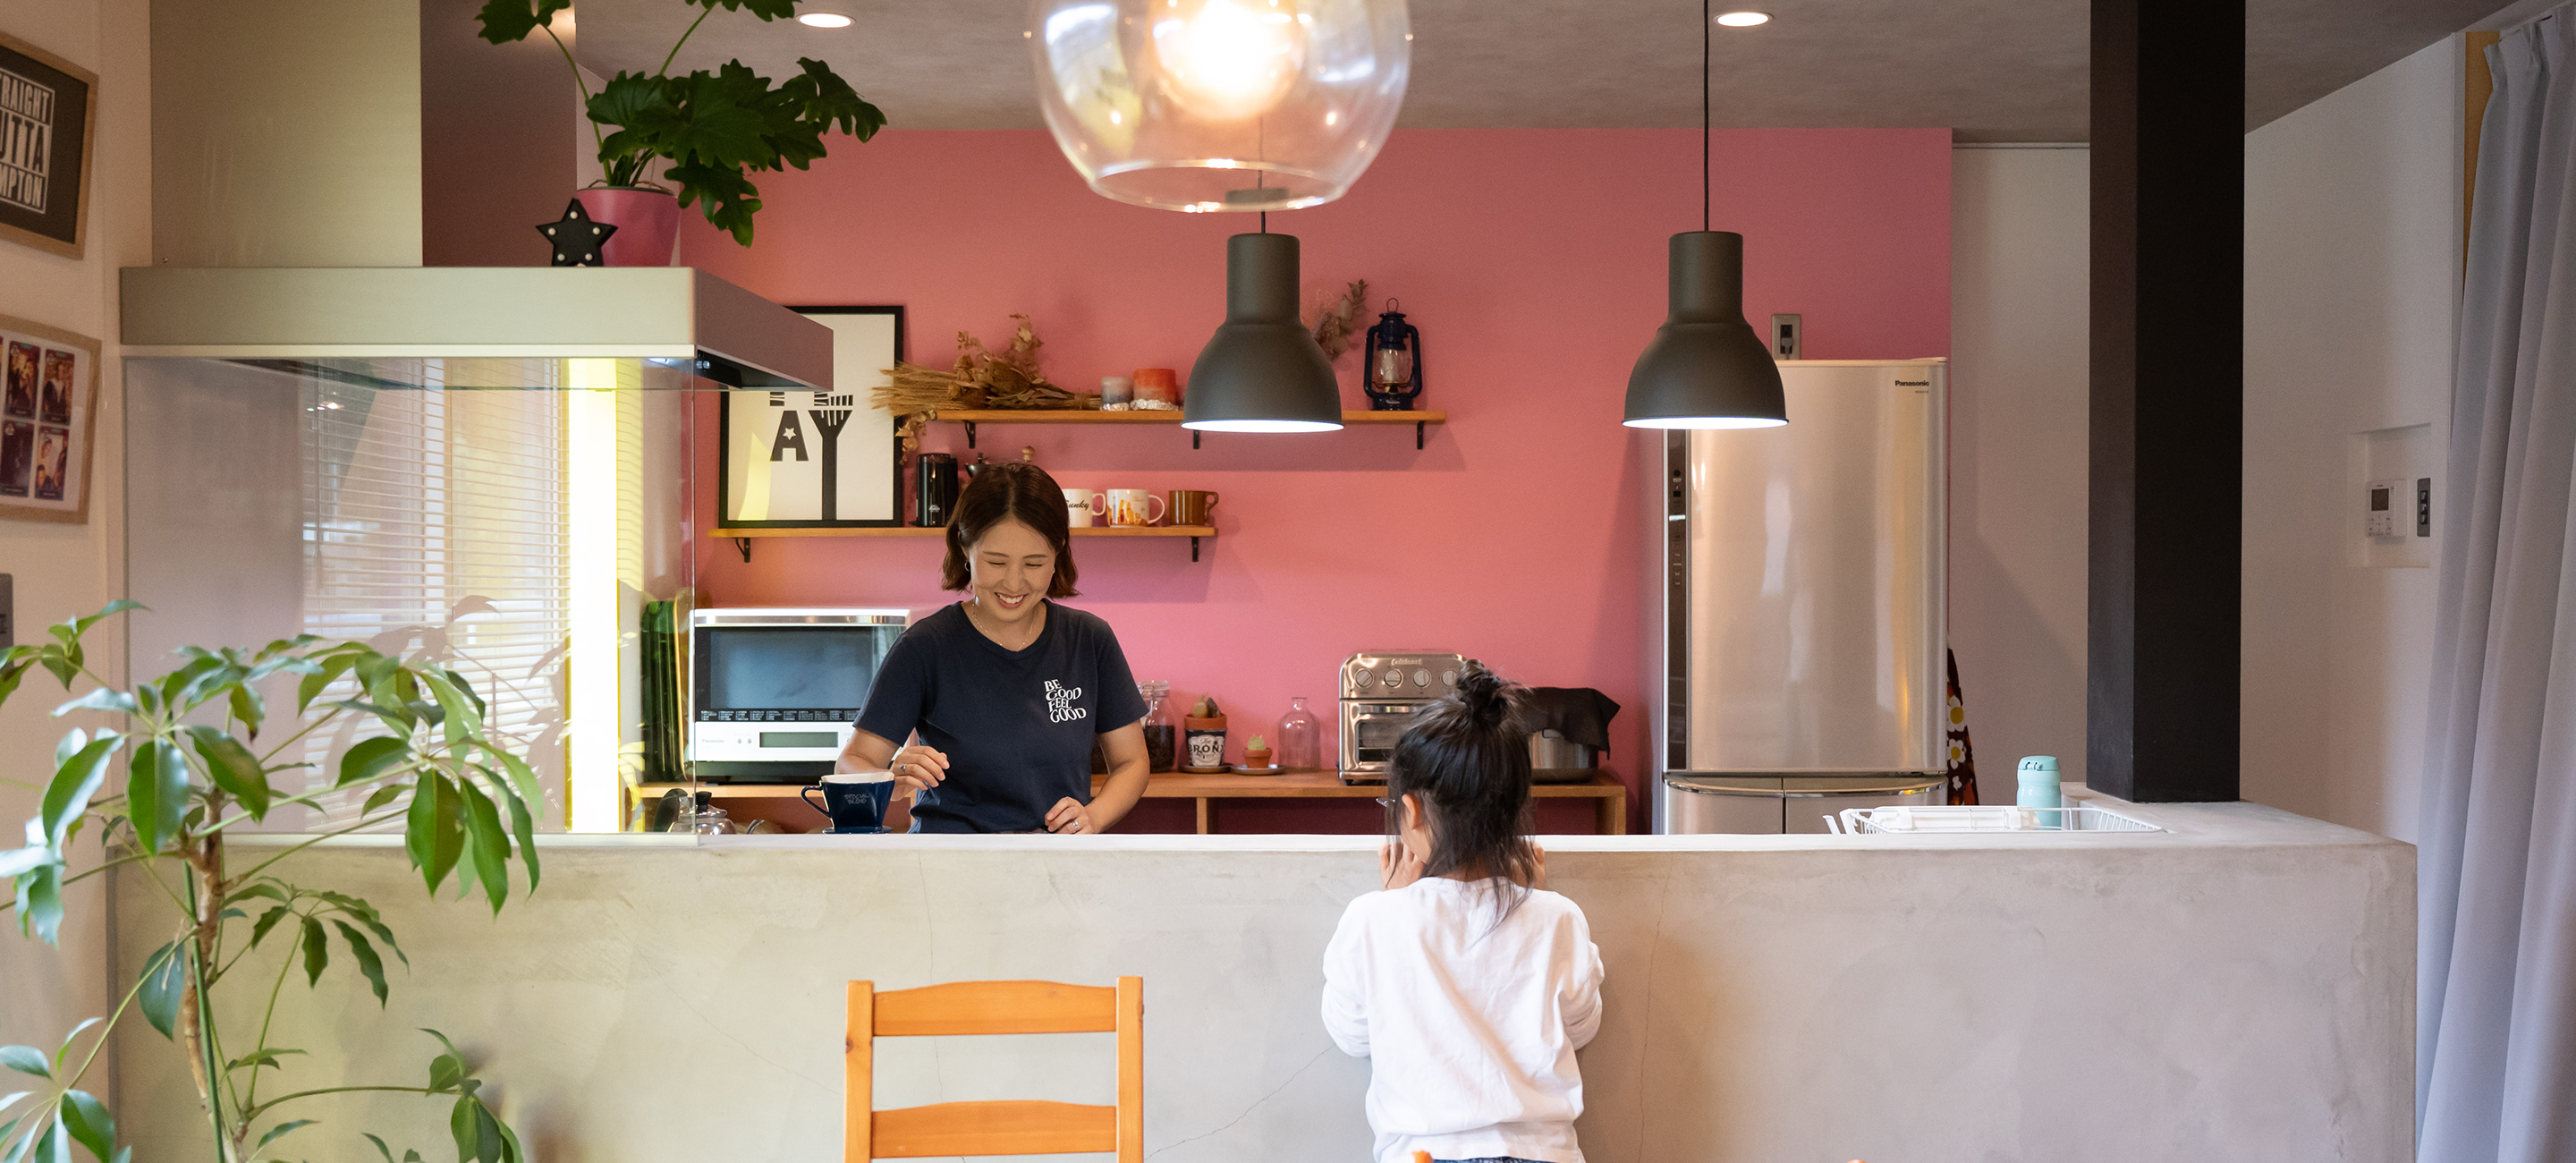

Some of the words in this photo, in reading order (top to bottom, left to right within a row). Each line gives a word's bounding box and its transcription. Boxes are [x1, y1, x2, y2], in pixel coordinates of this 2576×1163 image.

[1044, 679, 1062, 692] BE
[1046, 687, 1082, 700] GOOD
[1047, 698, 1072, 713] FEEL
[1050, 708, 1087, 723] GOOD
